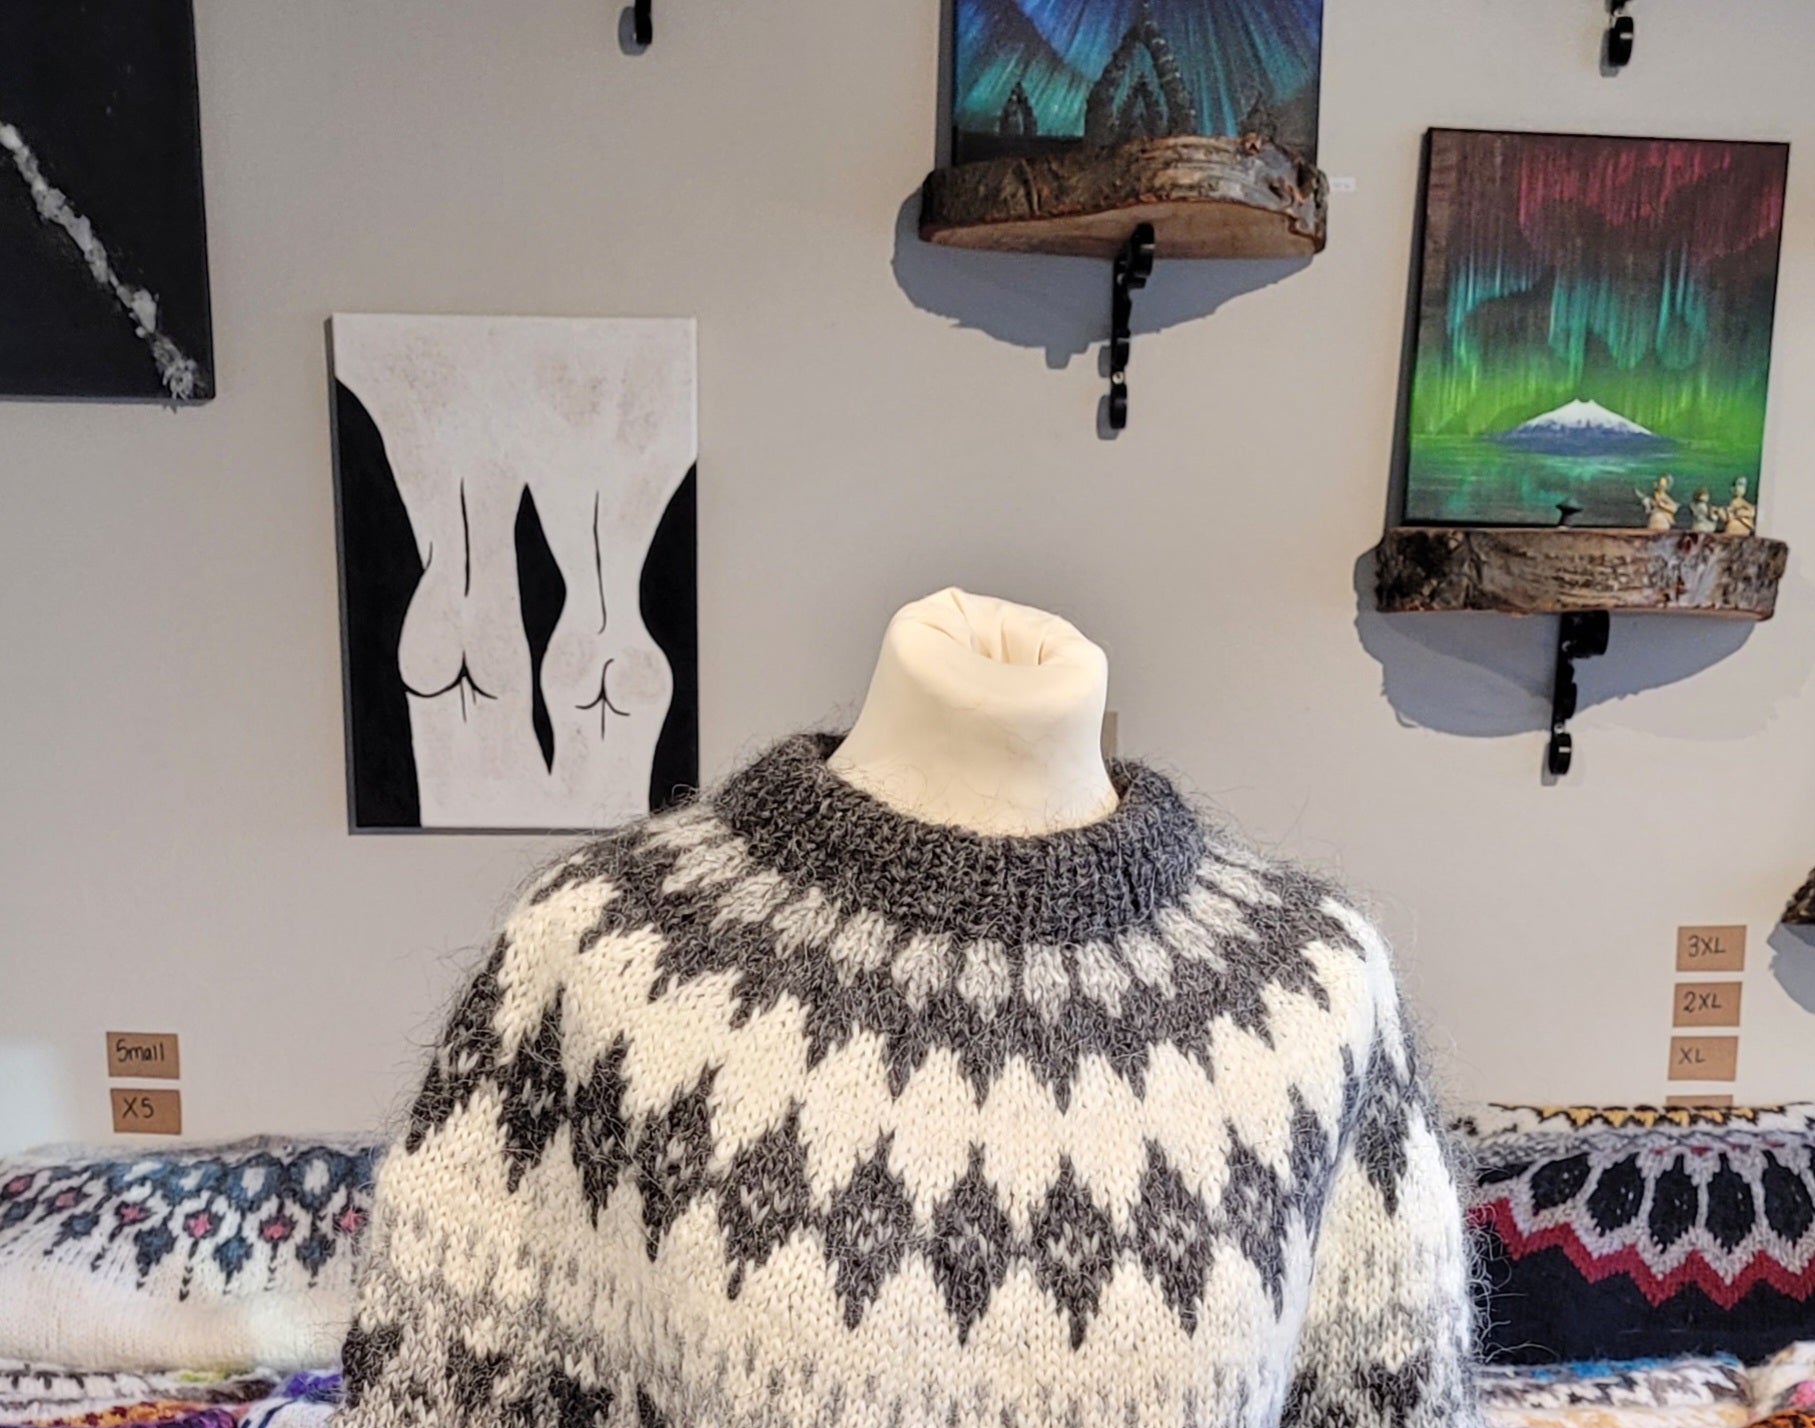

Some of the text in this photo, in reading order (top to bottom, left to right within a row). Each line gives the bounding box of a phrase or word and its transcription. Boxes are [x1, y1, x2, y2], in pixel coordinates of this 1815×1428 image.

[1688, 934, 1726, 957] 3XL
[1683, 990, 1722, 1013] 2XL
[116, 1038, 165, 1062] Small
[1678, 1046, 1706, 1065] XL
[122, 1096, 154, 1119] XS
